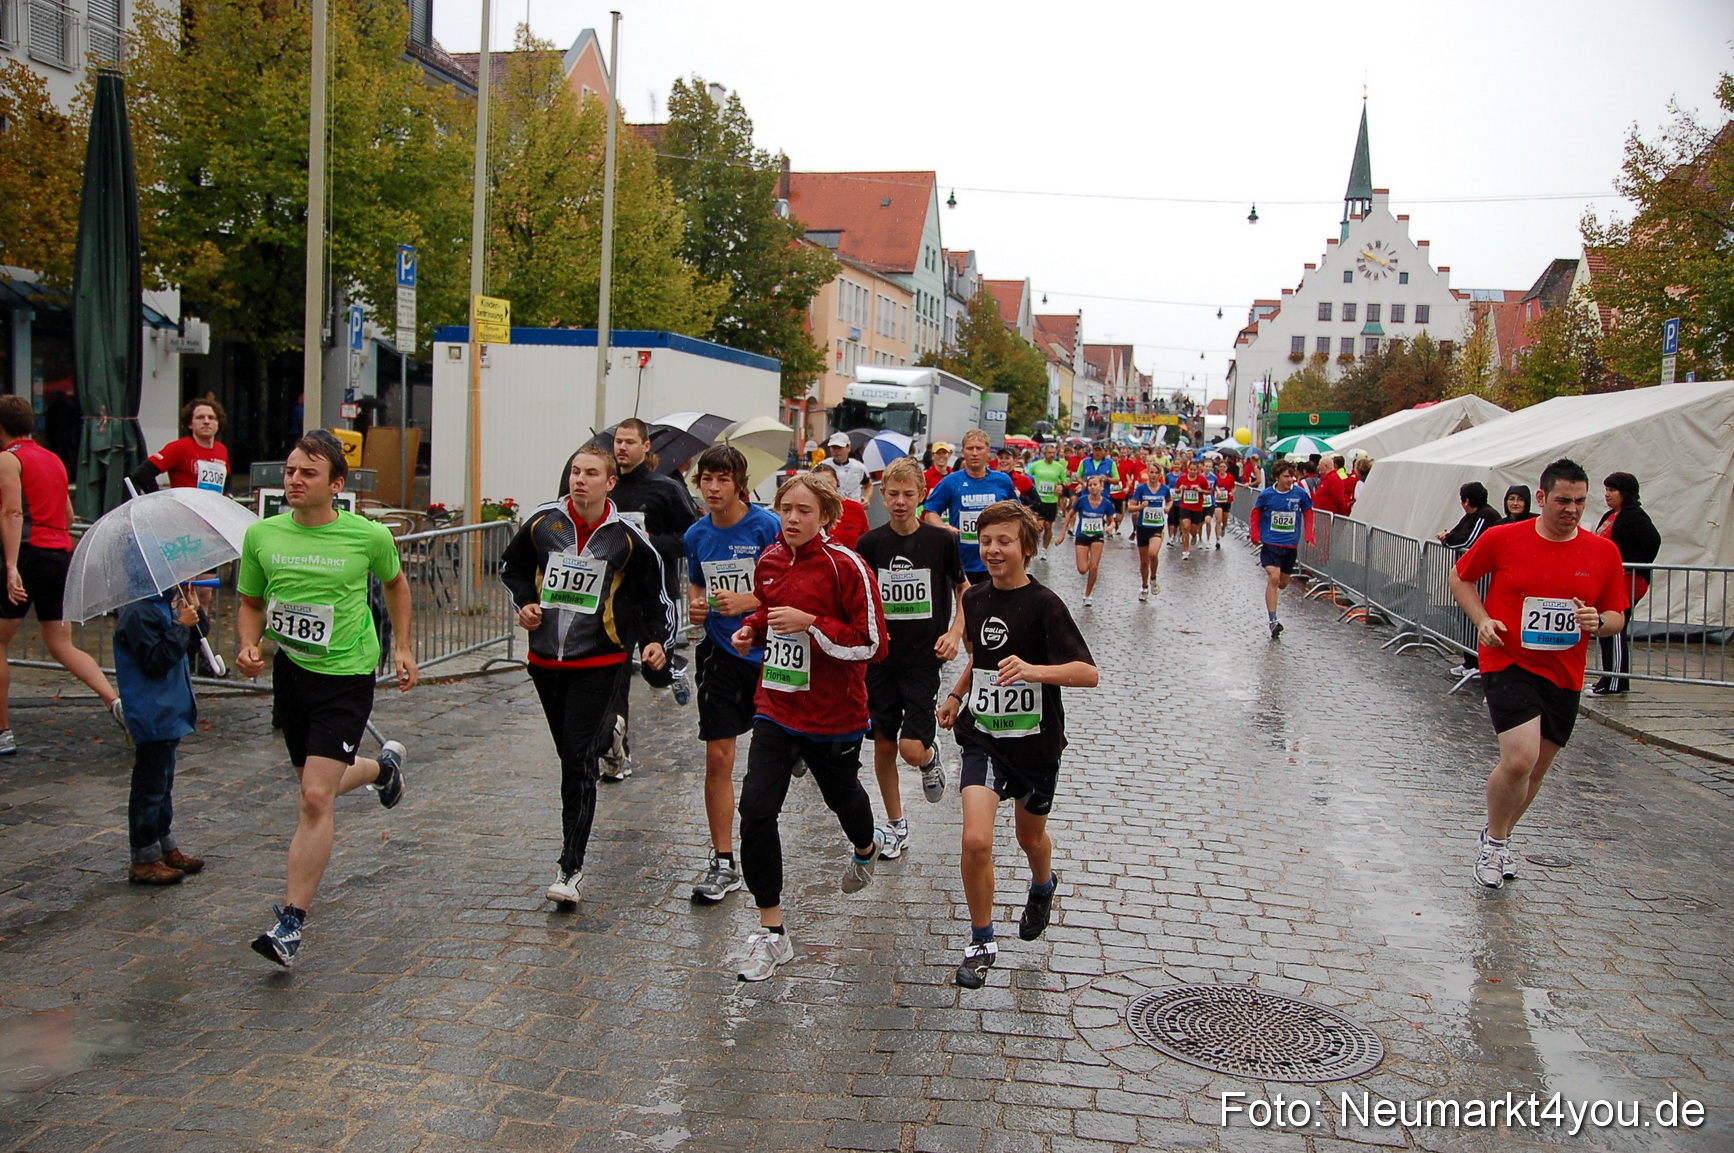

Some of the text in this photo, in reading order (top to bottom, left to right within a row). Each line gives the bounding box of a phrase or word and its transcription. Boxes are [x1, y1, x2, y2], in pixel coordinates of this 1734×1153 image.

[352, 312, 360, 344] P
[1666, 323, 1675, 350] P
[961, 494, 996, 504] HUBER
[963, 520, 978, 533] 50
[1273, 515, 1293, 526] 5024
[548, 567, 598, 593] 5197
[710, 572, 752, 593] 5071
[550, 593, 584, 604] Matthias
[881, 582, 926, 602] 5006
[892, 605, 915, 613] Johan
[272, 610, 326, 642] 5183
[1527, 611, 1576, 632] 2198
[1537, 634, 1565, 644] Florian
[764, 640, 804, 669] 5139
[766, 669, 791, 682] Florian
[976, 687, 1035, 714] 5120
[992, 719, 1015, 729] Niko
